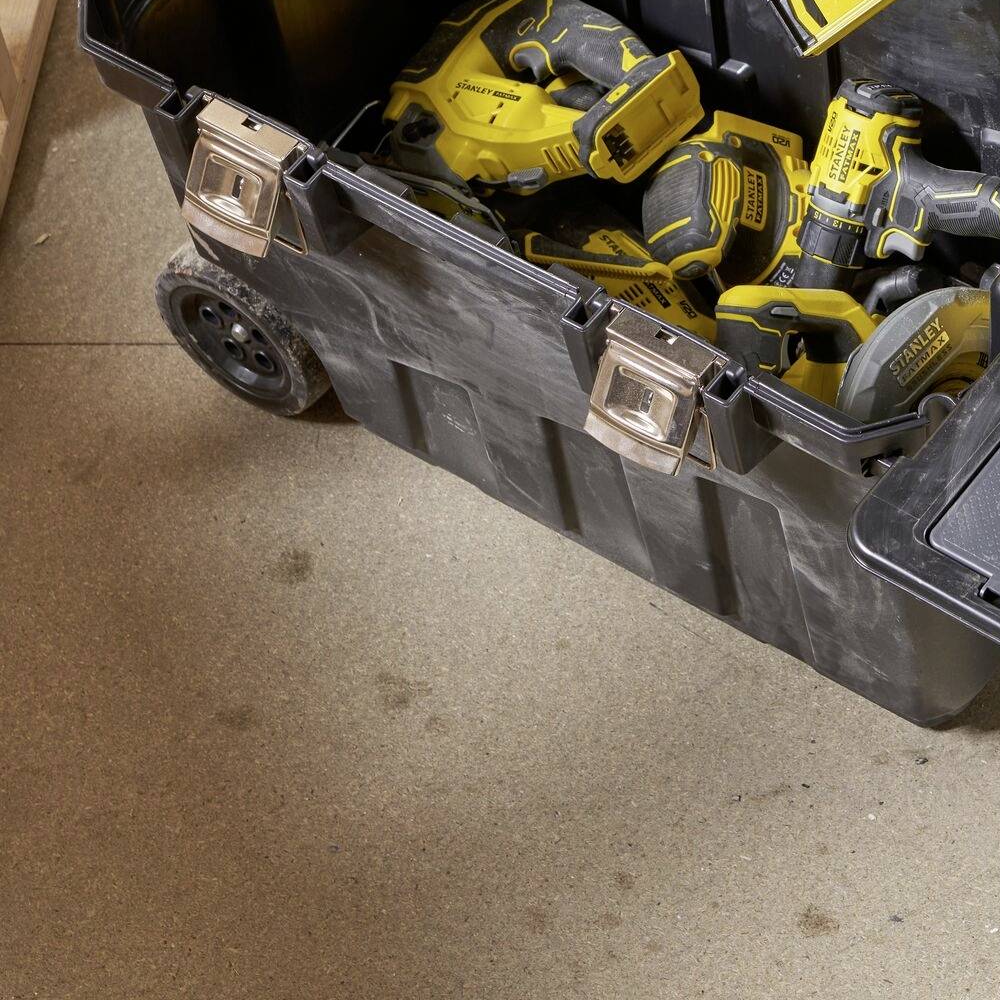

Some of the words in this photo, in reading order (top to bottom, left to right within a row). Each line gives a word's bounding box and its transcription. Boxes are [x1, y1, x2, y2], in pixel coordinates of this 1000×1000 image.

[455, 80, 493, 96] STANLEY
[829, 125, 850, 180] STANLEY
[839, 131, 860, 182] FATMAX
[745, 171, 757, 220] STANLEY
[754, 174, 763, 223] FATMAX
[890, 317, 942, 376] STANLEY
